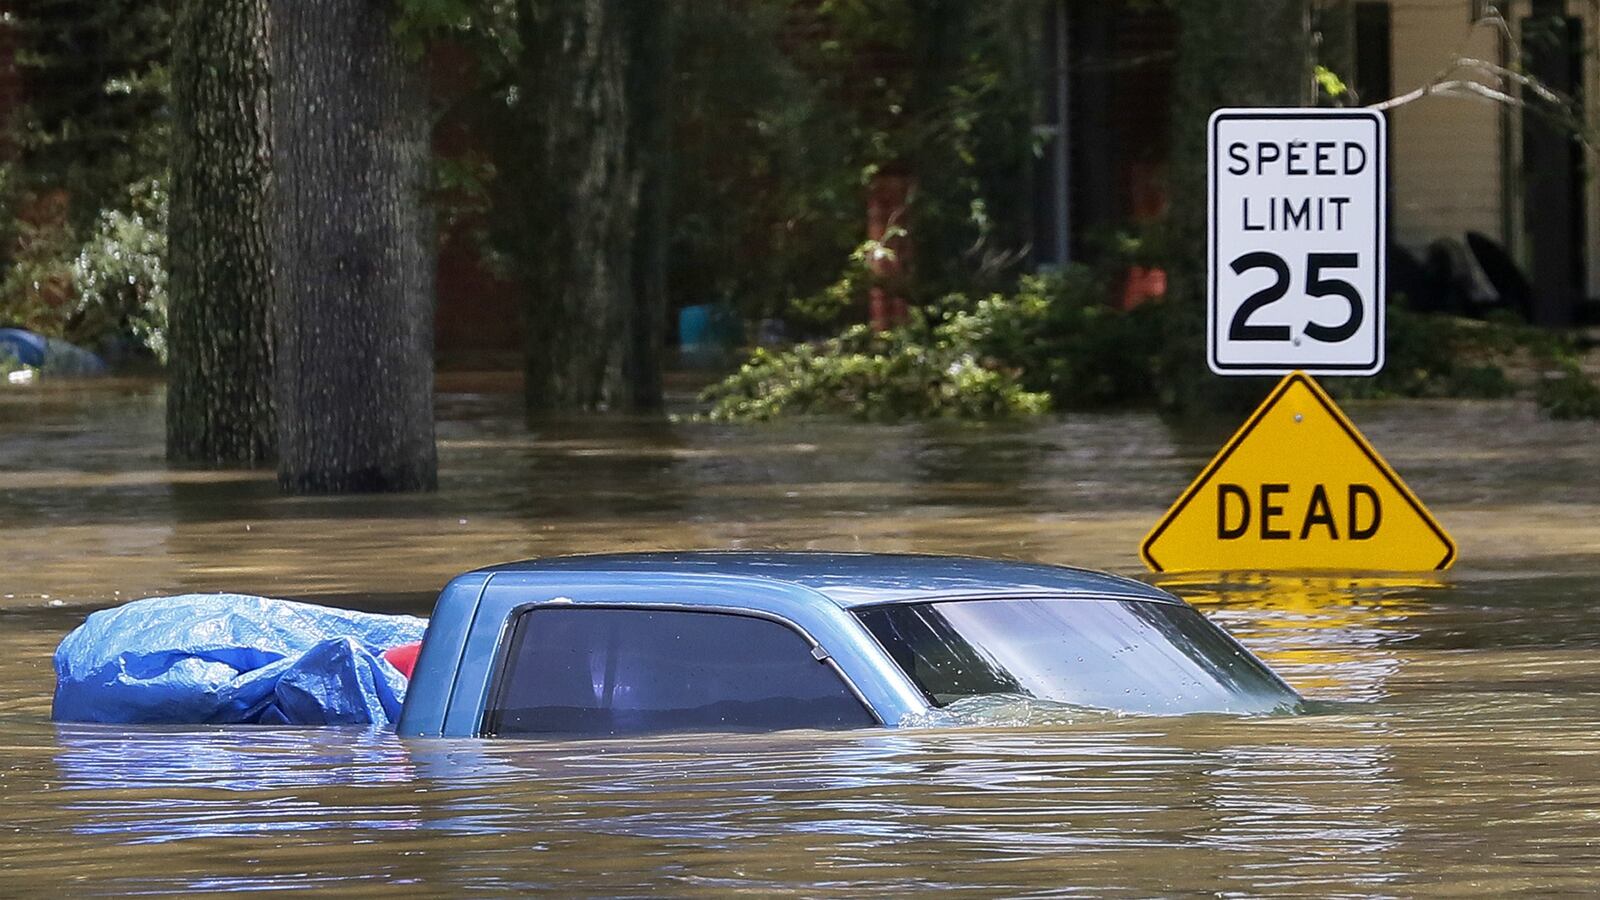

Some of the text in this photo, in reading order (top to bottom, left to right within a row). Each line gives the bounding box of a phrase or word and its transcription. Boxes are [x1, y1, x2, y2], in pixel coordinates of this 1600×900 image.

[1228, 141, 1366, 176] SPEED
[1243, 197, 1350, 231] LIMIT
[1229, 251, 1364, 343] 25
[1217, 483, 1382, 540] DEAD
